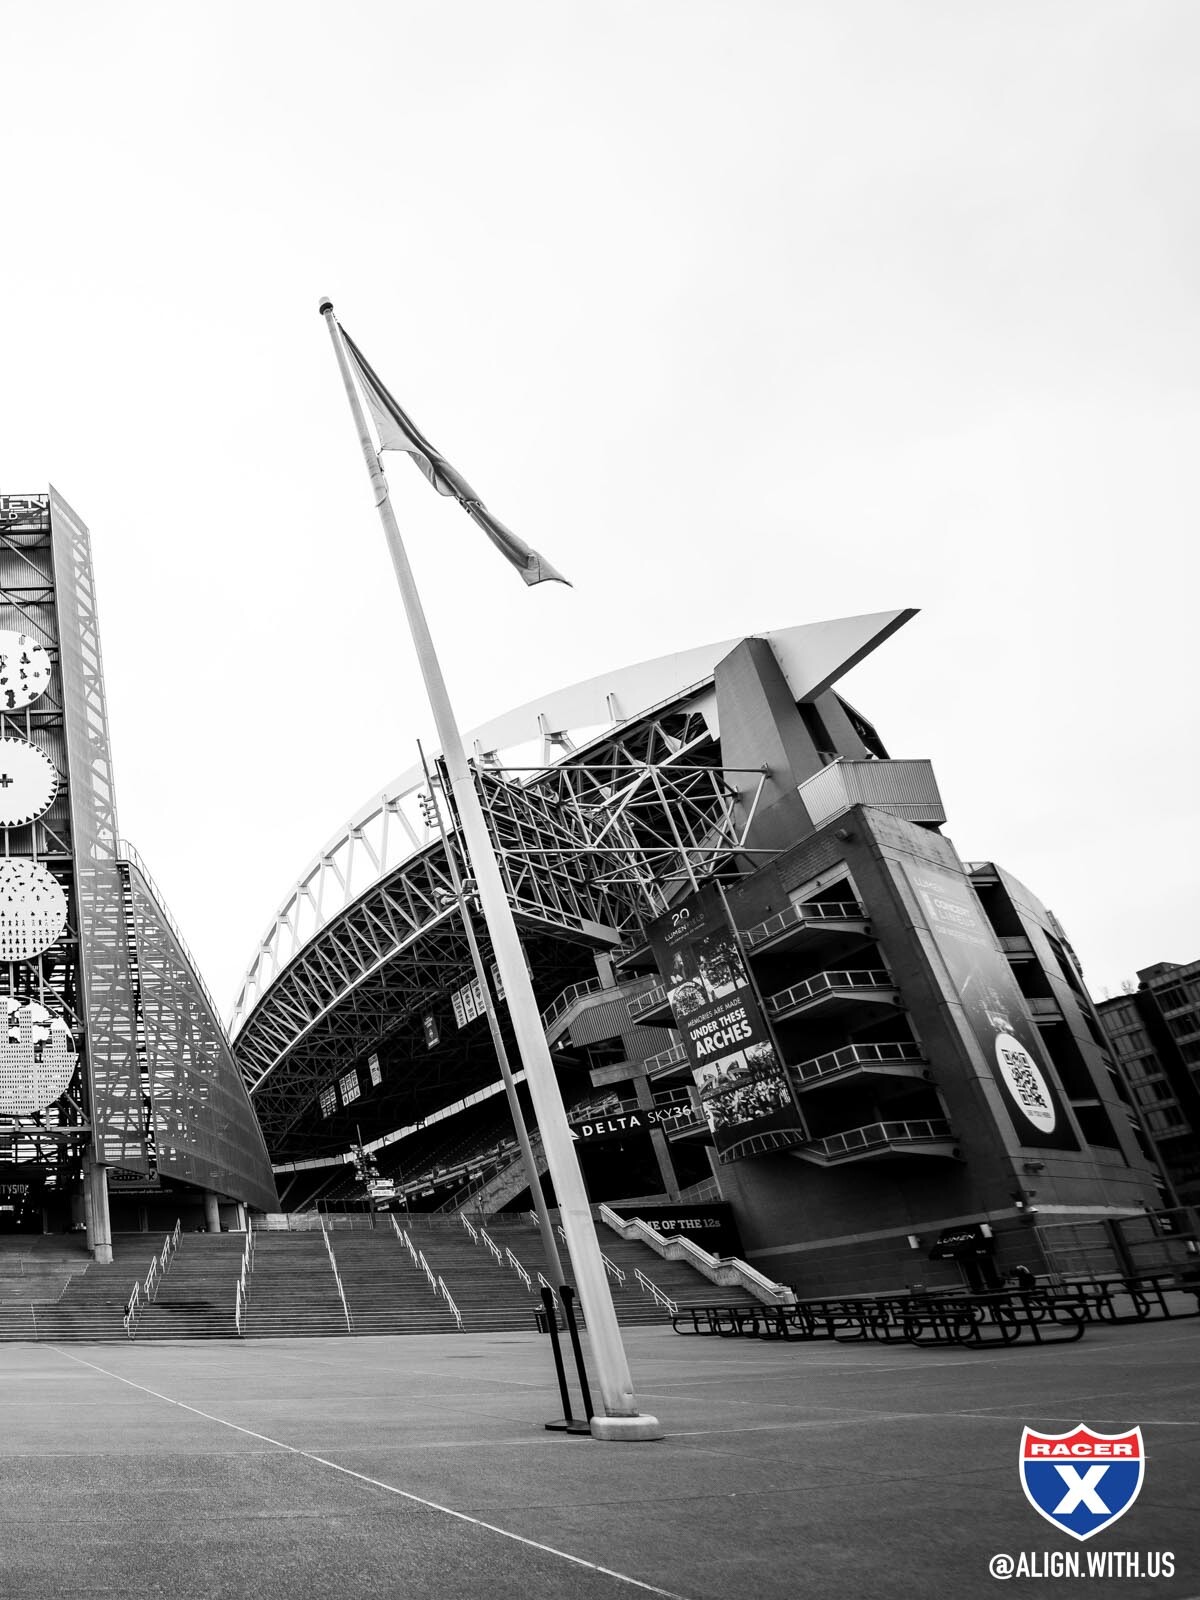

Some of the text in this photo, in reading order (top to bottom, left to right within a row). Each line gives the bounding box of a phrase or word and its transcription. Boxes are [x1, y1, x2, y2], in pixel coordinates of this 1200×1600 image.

[664, 924, 687, 942] LUMEN
[687, 996, 742, 1028] MEMORIES ARE MADE
[690, 1007, 747, 1041] UNDER THESE
[696, 1019, 753, 1059] ARCHES
[582, 1104, 691, 1137] DELTA SKY36
[662, 1220, 676, 1230] OF
[678, 1219, 702, 1229] THE
[702, 1218, 721, 1228] 12s
[936, 1233, 976, 1245] LUMEN
